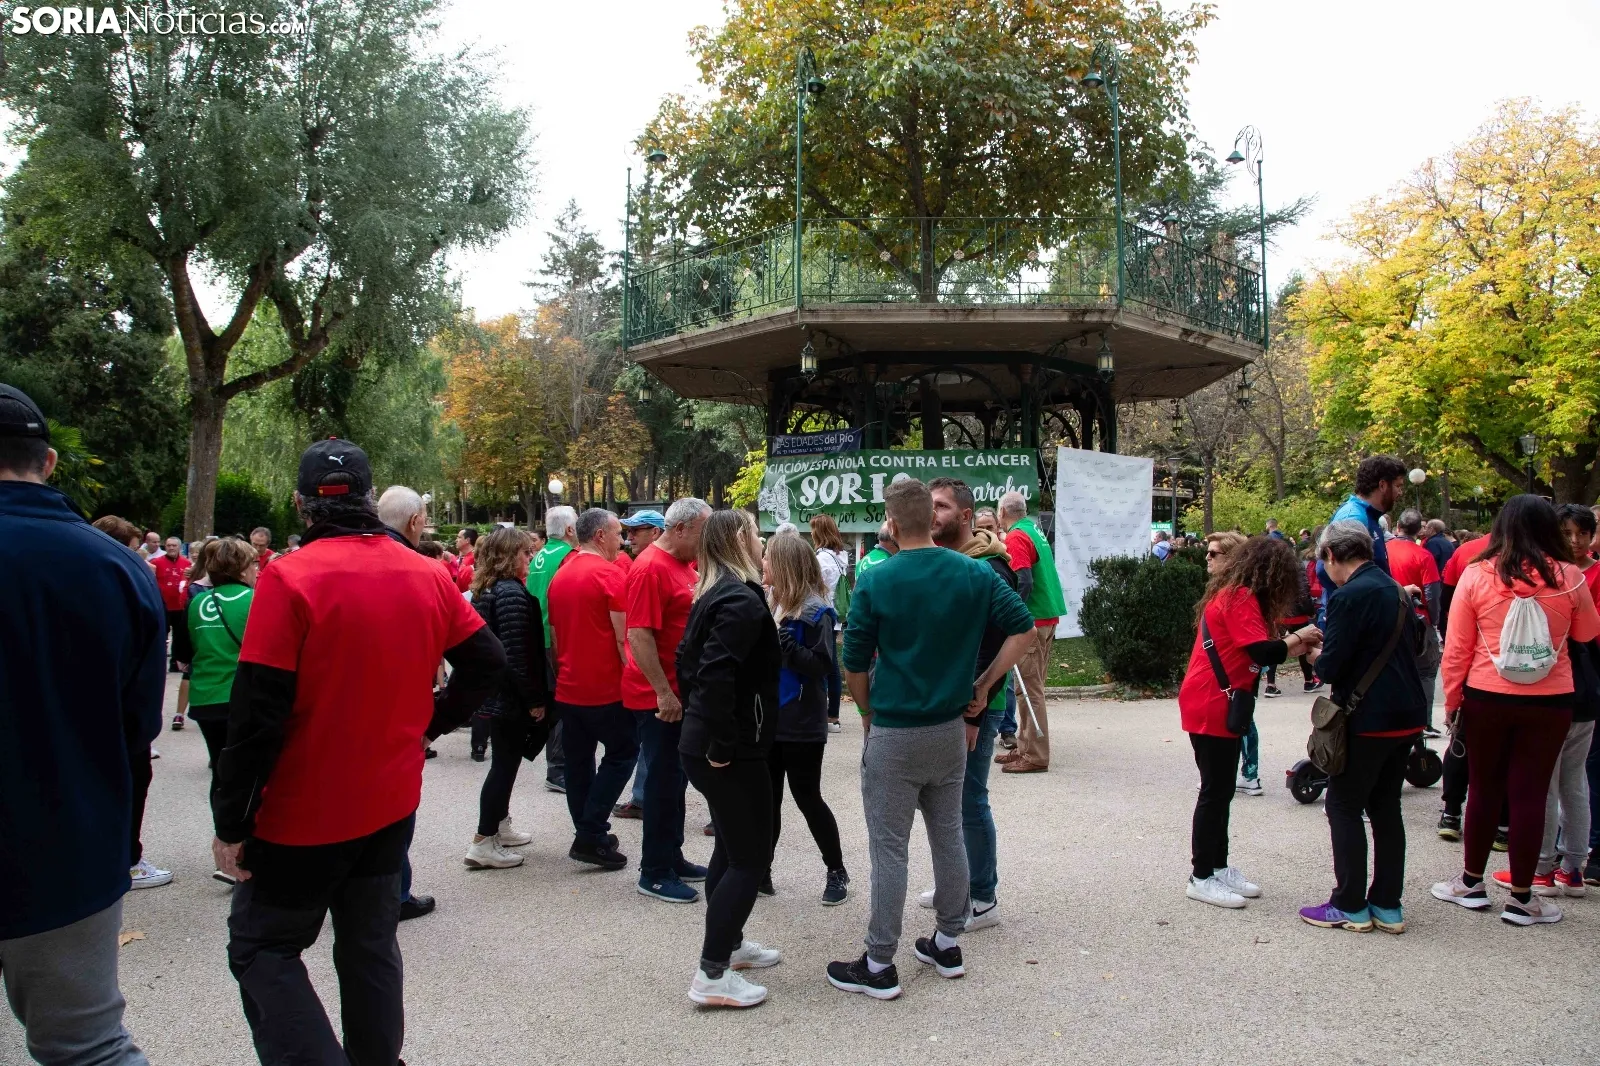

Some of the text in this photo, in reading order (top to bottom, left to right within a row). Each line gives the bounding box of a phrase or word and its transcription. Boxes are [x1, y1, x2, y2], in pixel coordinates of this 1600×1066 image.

[791, 435, 824, 448] EDADES
[824, 434, 838, 445] del
[839, 433, 854, 444] Río
[810, 455, 866, 471] ESPAÑOLA
[869, 455, 937, 468] CONTRA
[942, 456, 960, 467] EL
[963, 452, 1030, 467] CÁNCER
[800, 472, 1032, 507] SORI archa
